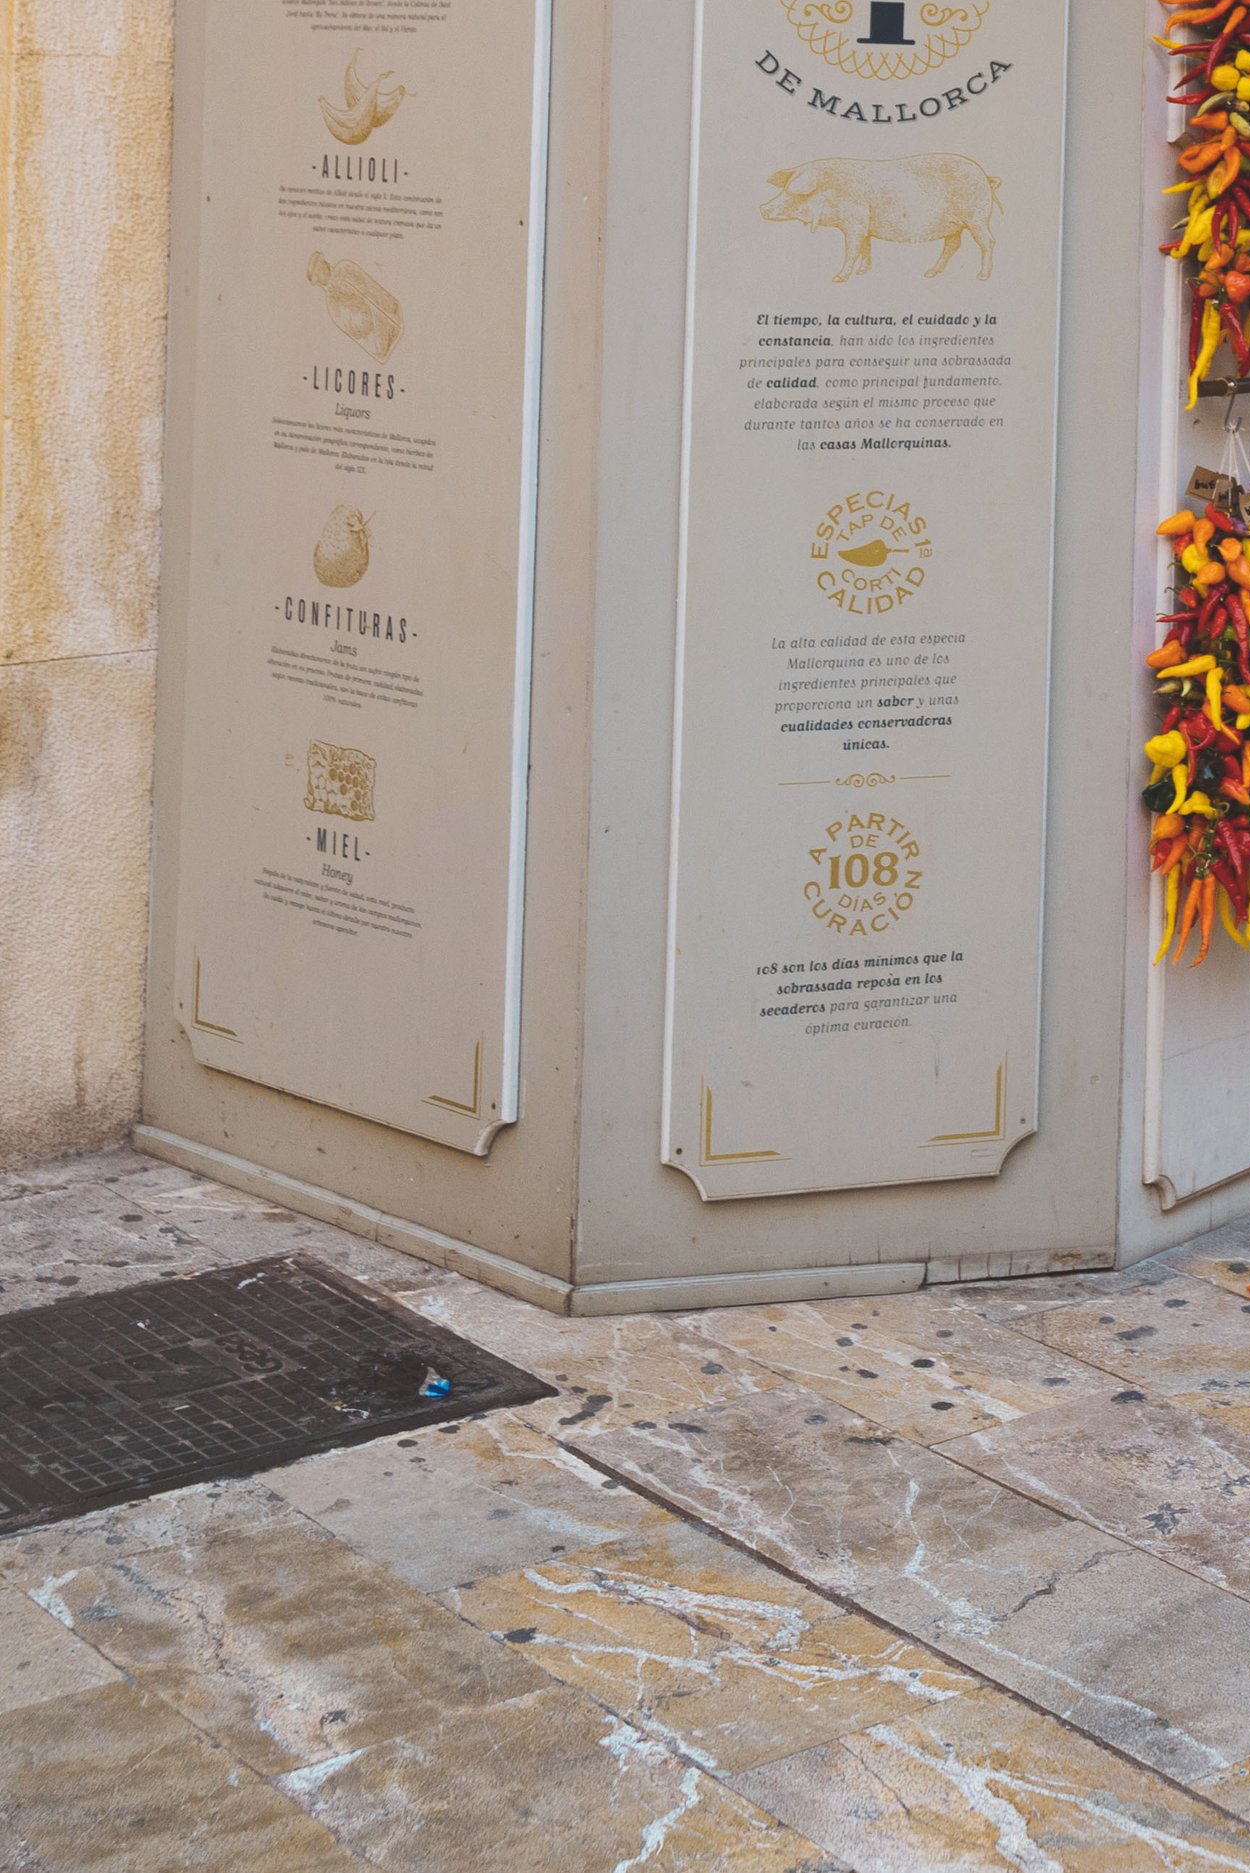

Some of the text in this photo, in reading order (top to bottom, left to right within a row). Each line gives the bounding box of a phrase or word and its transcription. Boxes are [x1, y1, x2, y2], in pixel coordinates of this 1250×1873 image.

[755, 50, 1013, 123] DE MALLORCA
[322, 154, 398, 183] ALLIOLI
[756, 314, 769, 326] El
[827, 314, 840, 326] la
[902, 314, 913, 325] el
[917, 314, 970, 325] cuidado
[972, 317, 982, 327] y
[984, 313, 997, 325] la
[840, 335, 864, 347] han
[868, 335, 893, 346] sido
[898, 335, 915, 346] los
[919, 334, 994, 349] ingredientes
[739, 355, 1011, 370] principales para conseguir una sobrassada
[313, 366, 394, 399] LICORES
[747, 378, 763, 389] de
[825, 378, 858, 388] como
[862, 376, 919, 390] principal
[335, 402, 371, 420] Liquors
[754, 397, 996, 411] elaborada según el mismo proceso que
[744, 416, 1004, 431] durante tantos años se ha conservado en
[797, 437, 951, 451] las casas Mallorquinas.
[811, 490, 927, 559] ESPECIAS
[836, 514, 907, 542] TAP DE
[841, 567, 901, 592] CORTI
[817, 566, 925, 615] CALIDAD
[285, 596, 407, 643] CONFITURAS
[330, 640, 358, 656] Jams
[772, 632, 966, 650] La alta calidad de esta especia
[787, 653, 950, 671] Mallorquina es uno de los
[778, 674, 957, 693] ingredientes principales que
[774, 694, 959, 714] proporciona un sabor y unas
[780, 716, 952, 733] cualidades conservadoras
[843, 739, 890, 752] únicas.
[317, 827, 361, 861] MIEL
[808, 812, 920, 865] A PARTIR
[850, 834, 879, 848] DE
[321, 863, 354, 886] Honey
[828, 852, 899, 890] 108
[803, 870, 923, 936] CURACIÓN
[838, 892, 886, 912] DÍAS
[756, 950, 964, 975] 108 son los días mínimos que la
[777, 973, 943, 995] sobrassada reposa en los
[759, 993, 957, 1017] secaderos para garantizar una
